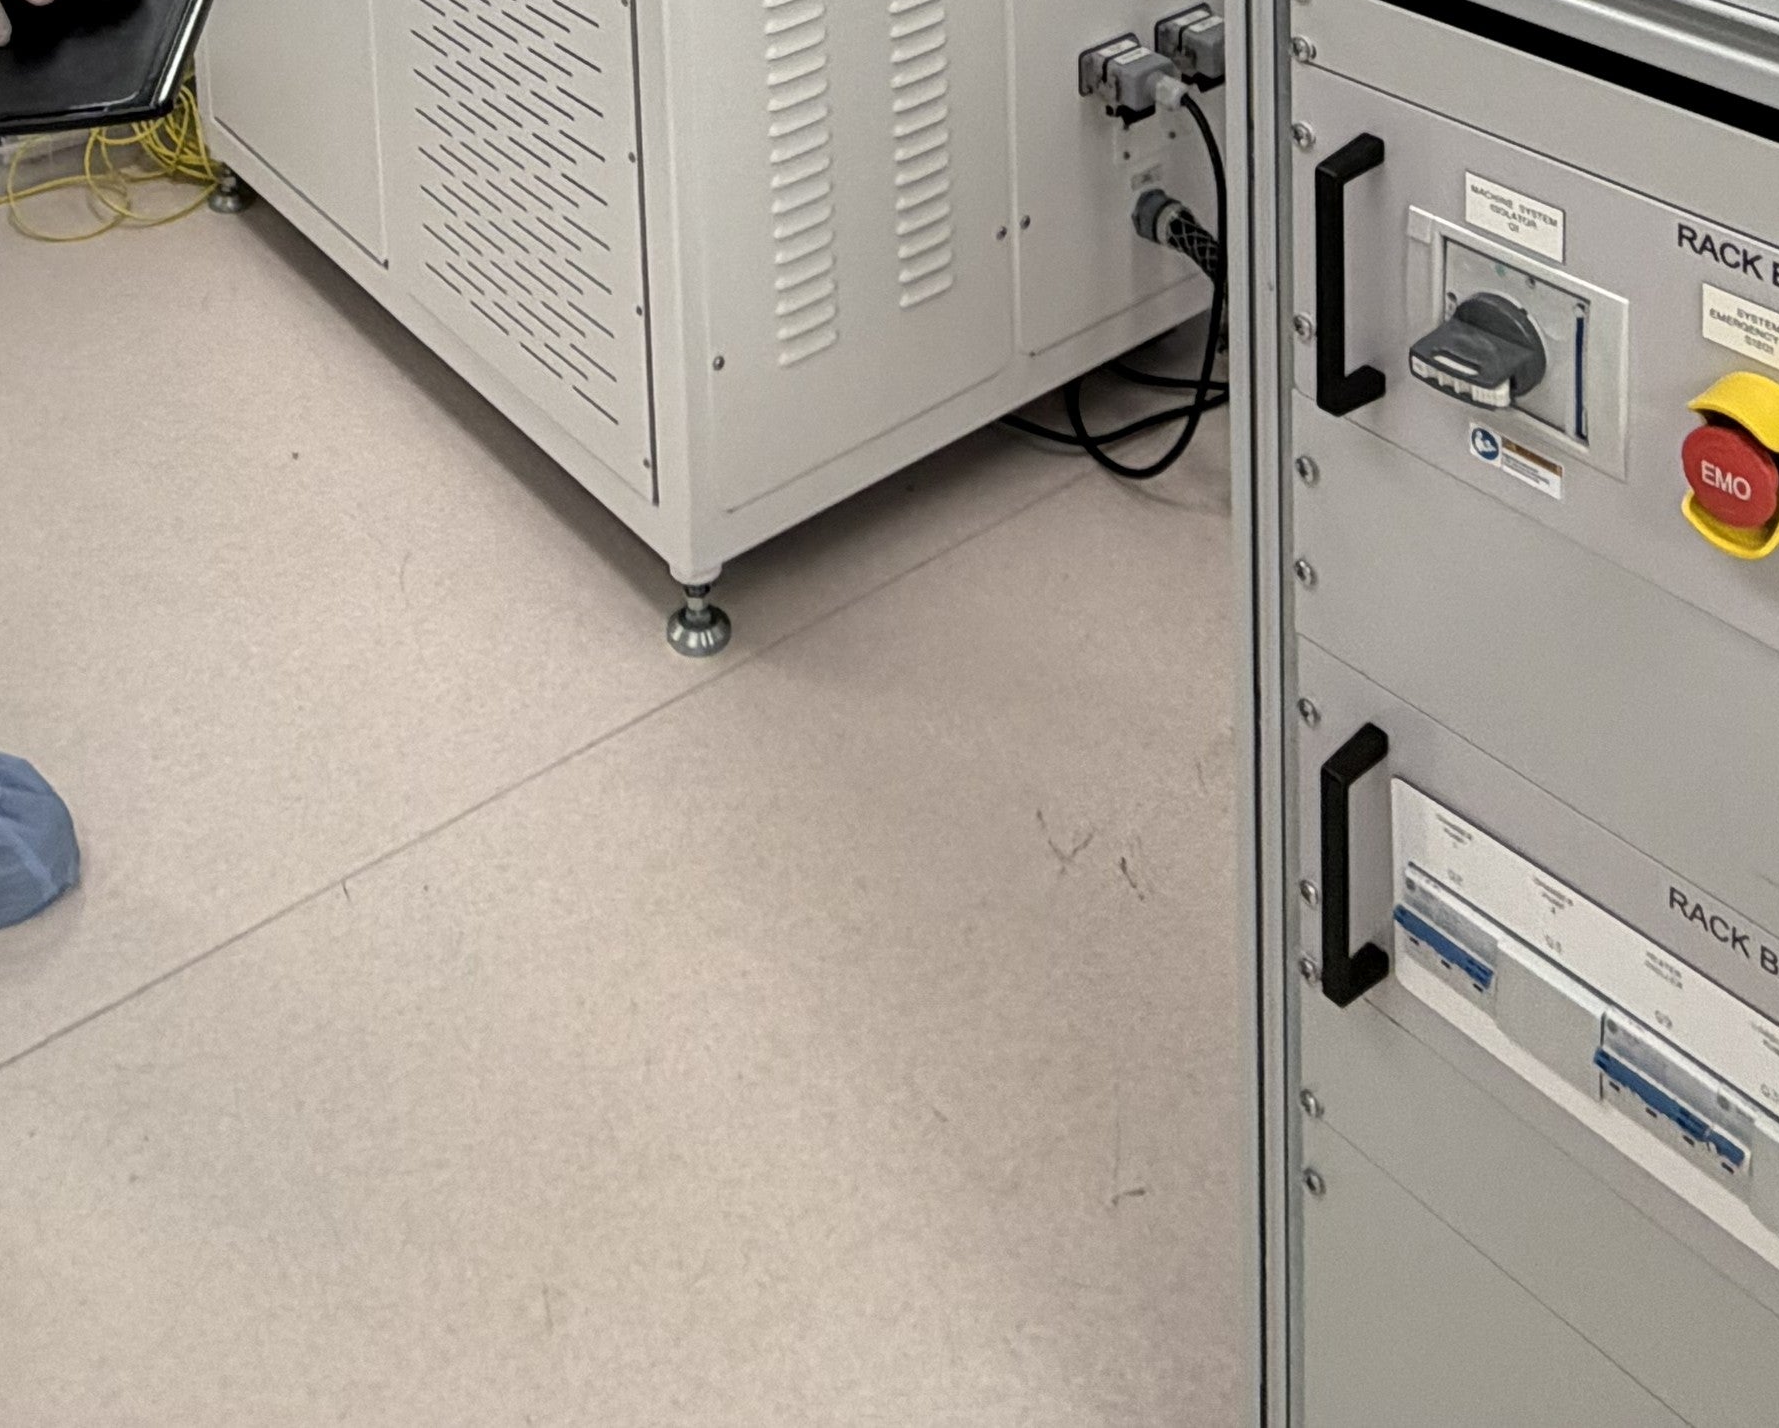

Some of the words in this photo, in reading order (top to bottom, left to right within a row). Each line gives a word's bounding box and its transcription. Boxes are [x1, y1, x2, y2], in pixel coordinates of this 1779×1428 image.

[1677, 223, 1764, 281] RACK
[1709, 307, 1779, 344] EMERGENCY
[1700, 459, 1751, 502] EMO
[1669, 886, 1750, 959] RACK
